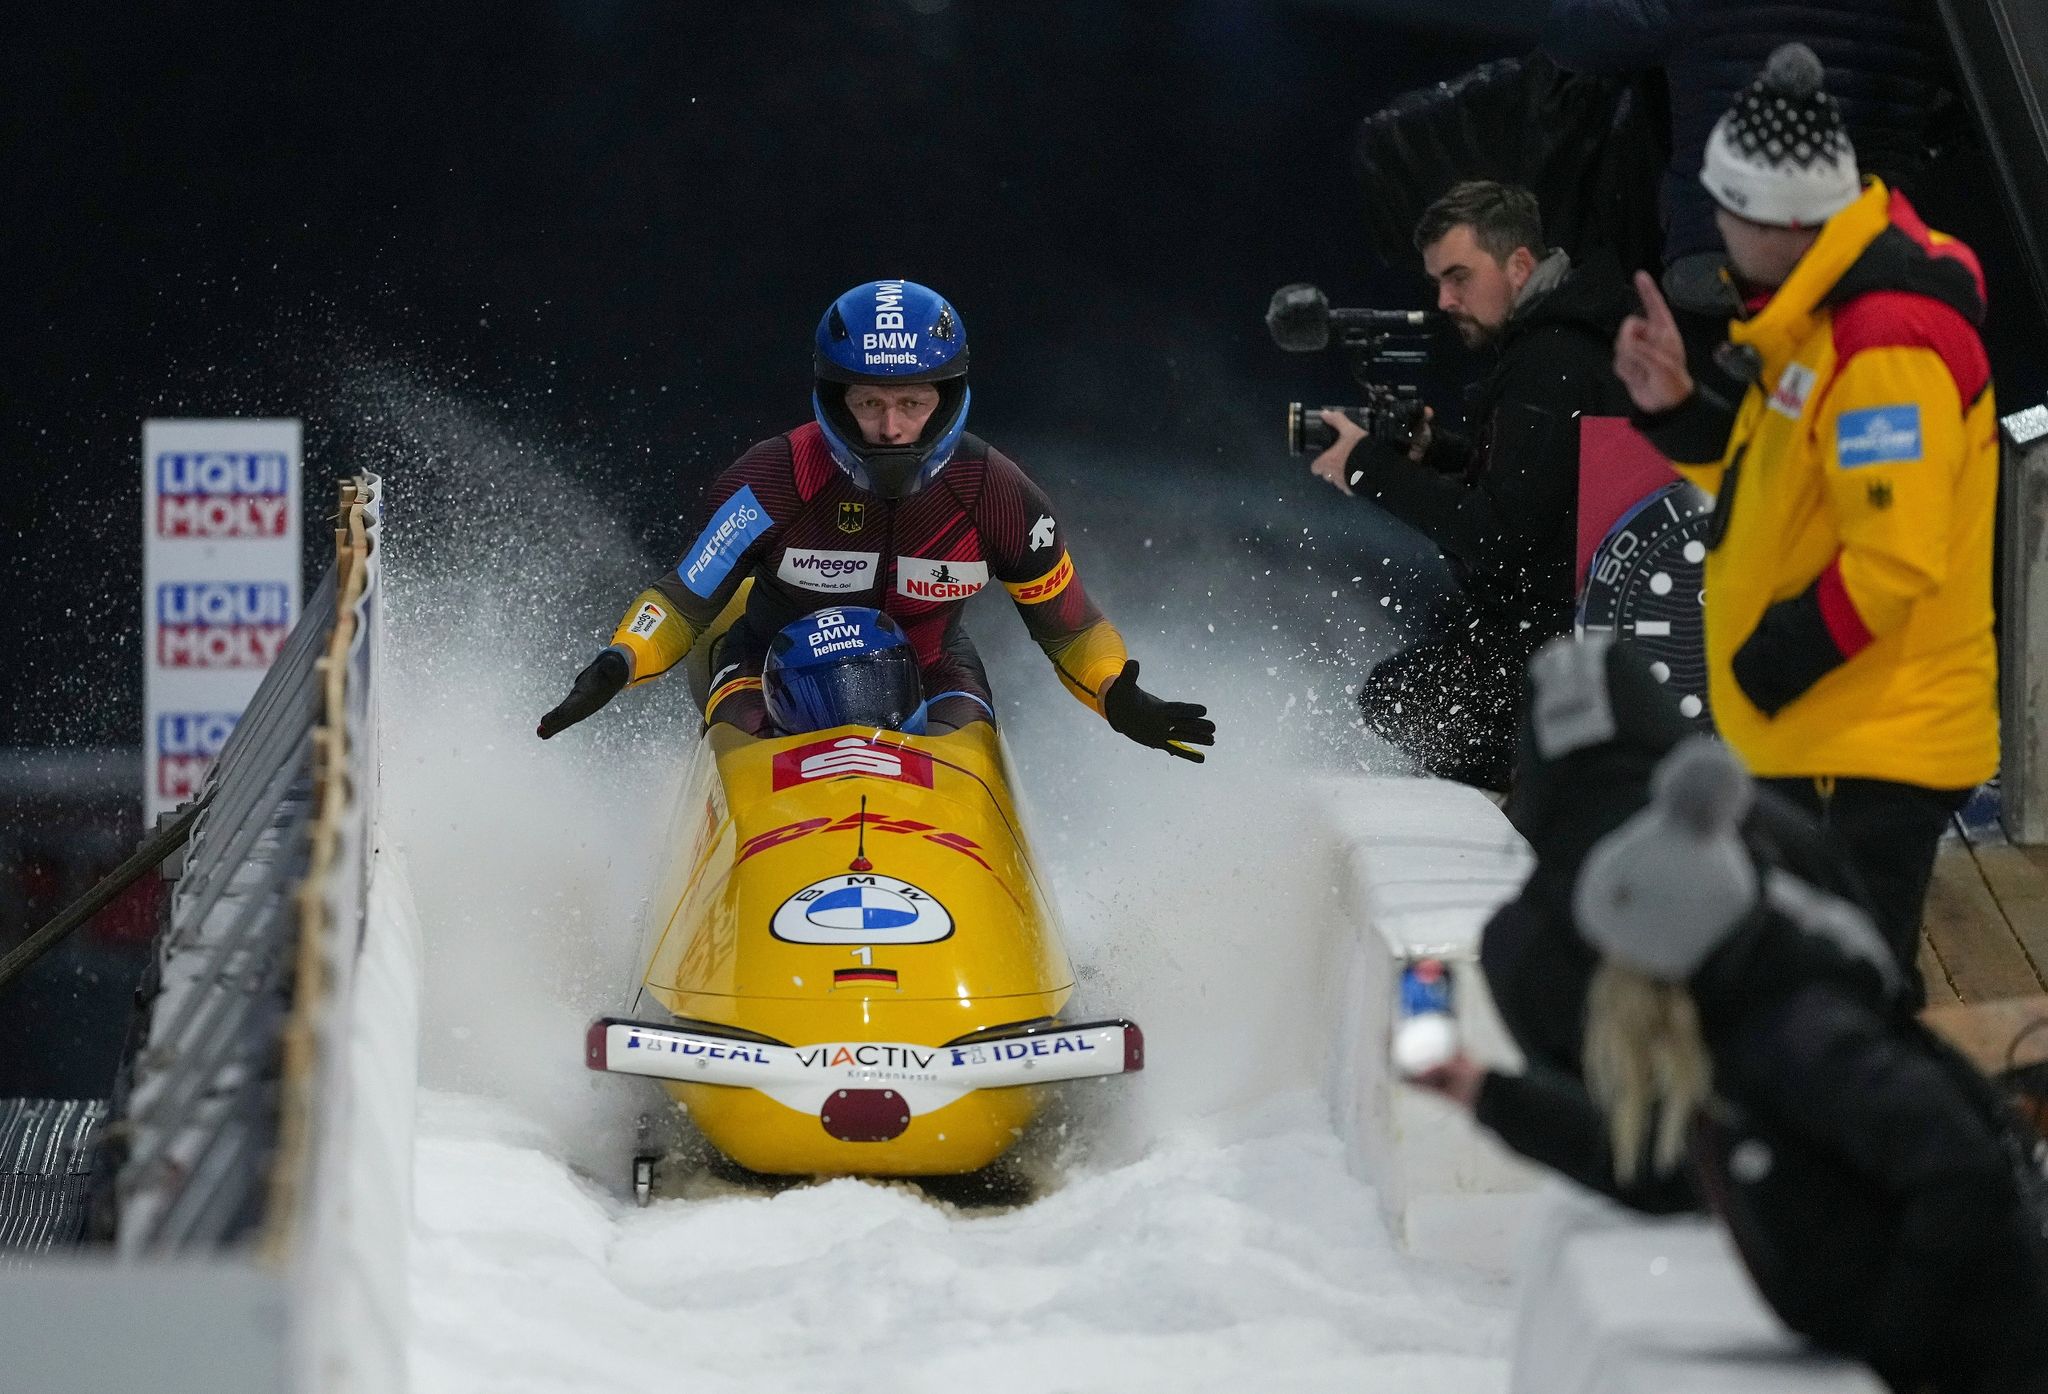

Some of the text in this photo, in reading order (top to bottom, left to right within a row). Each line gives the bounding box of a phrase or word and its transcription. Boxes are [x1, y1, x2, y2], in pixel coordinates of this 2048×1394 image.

[875, 280, 904, 330] BMW
[863, 333, 918, 350] BMW
[865, 352, 917, 365] helmets
[160, 456, 284, 494] LIQUI
[160, 497, 286, 537] MOLY
[792, 554, 868, 575] wheego
[1597, 530, 1639, 585] 50
[906, 578, 982, 598] NIGRIN
[1018, 562, 1069, 600] DHL
[160, 587, 284, 625] LIQUI
[160, 628, 285, 667] MOLY
[808, 624, 860, 647] BMW
[813, 639, 864, 657] helmets
[794, 876, 930, 902] BMW
[851, 946, 873, 966] 1
[671, 1035, 1095, 1069] IDEAL VIACTIV IDEAL
